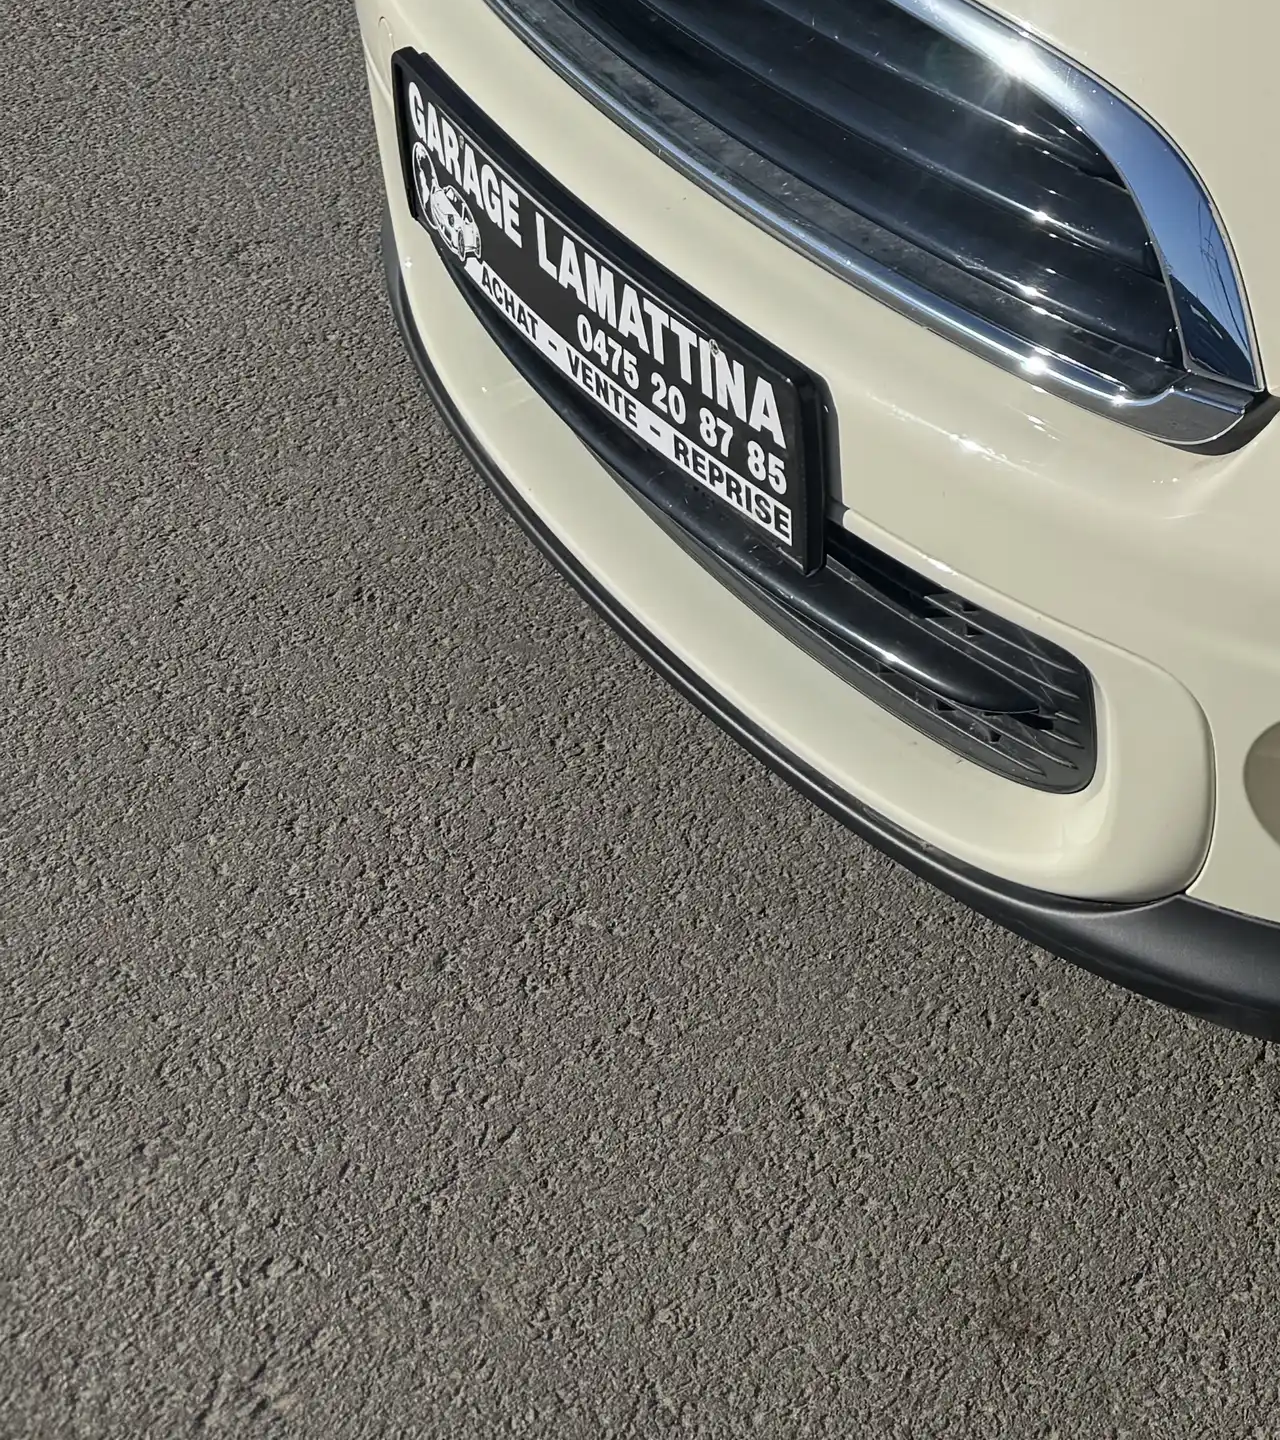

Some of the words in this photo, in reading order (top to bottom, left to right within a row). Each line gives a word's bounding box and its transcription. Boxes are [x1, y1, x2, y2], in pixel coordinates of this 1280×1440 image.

[409, 82, 522, 248] GARAGE
[536, 212, 786, 449] LAMATTINA
[481, 263, 537, 340] ACHAT
[566, 348, 638, 428] VENTE
[674, 435, 790, 539] REPRISE
[577, 314, 639, 389] 0475
[651, 372, 686, 424] 20
[700, 408, 733, 457] 87
[748, 441, 787, 494] 85
